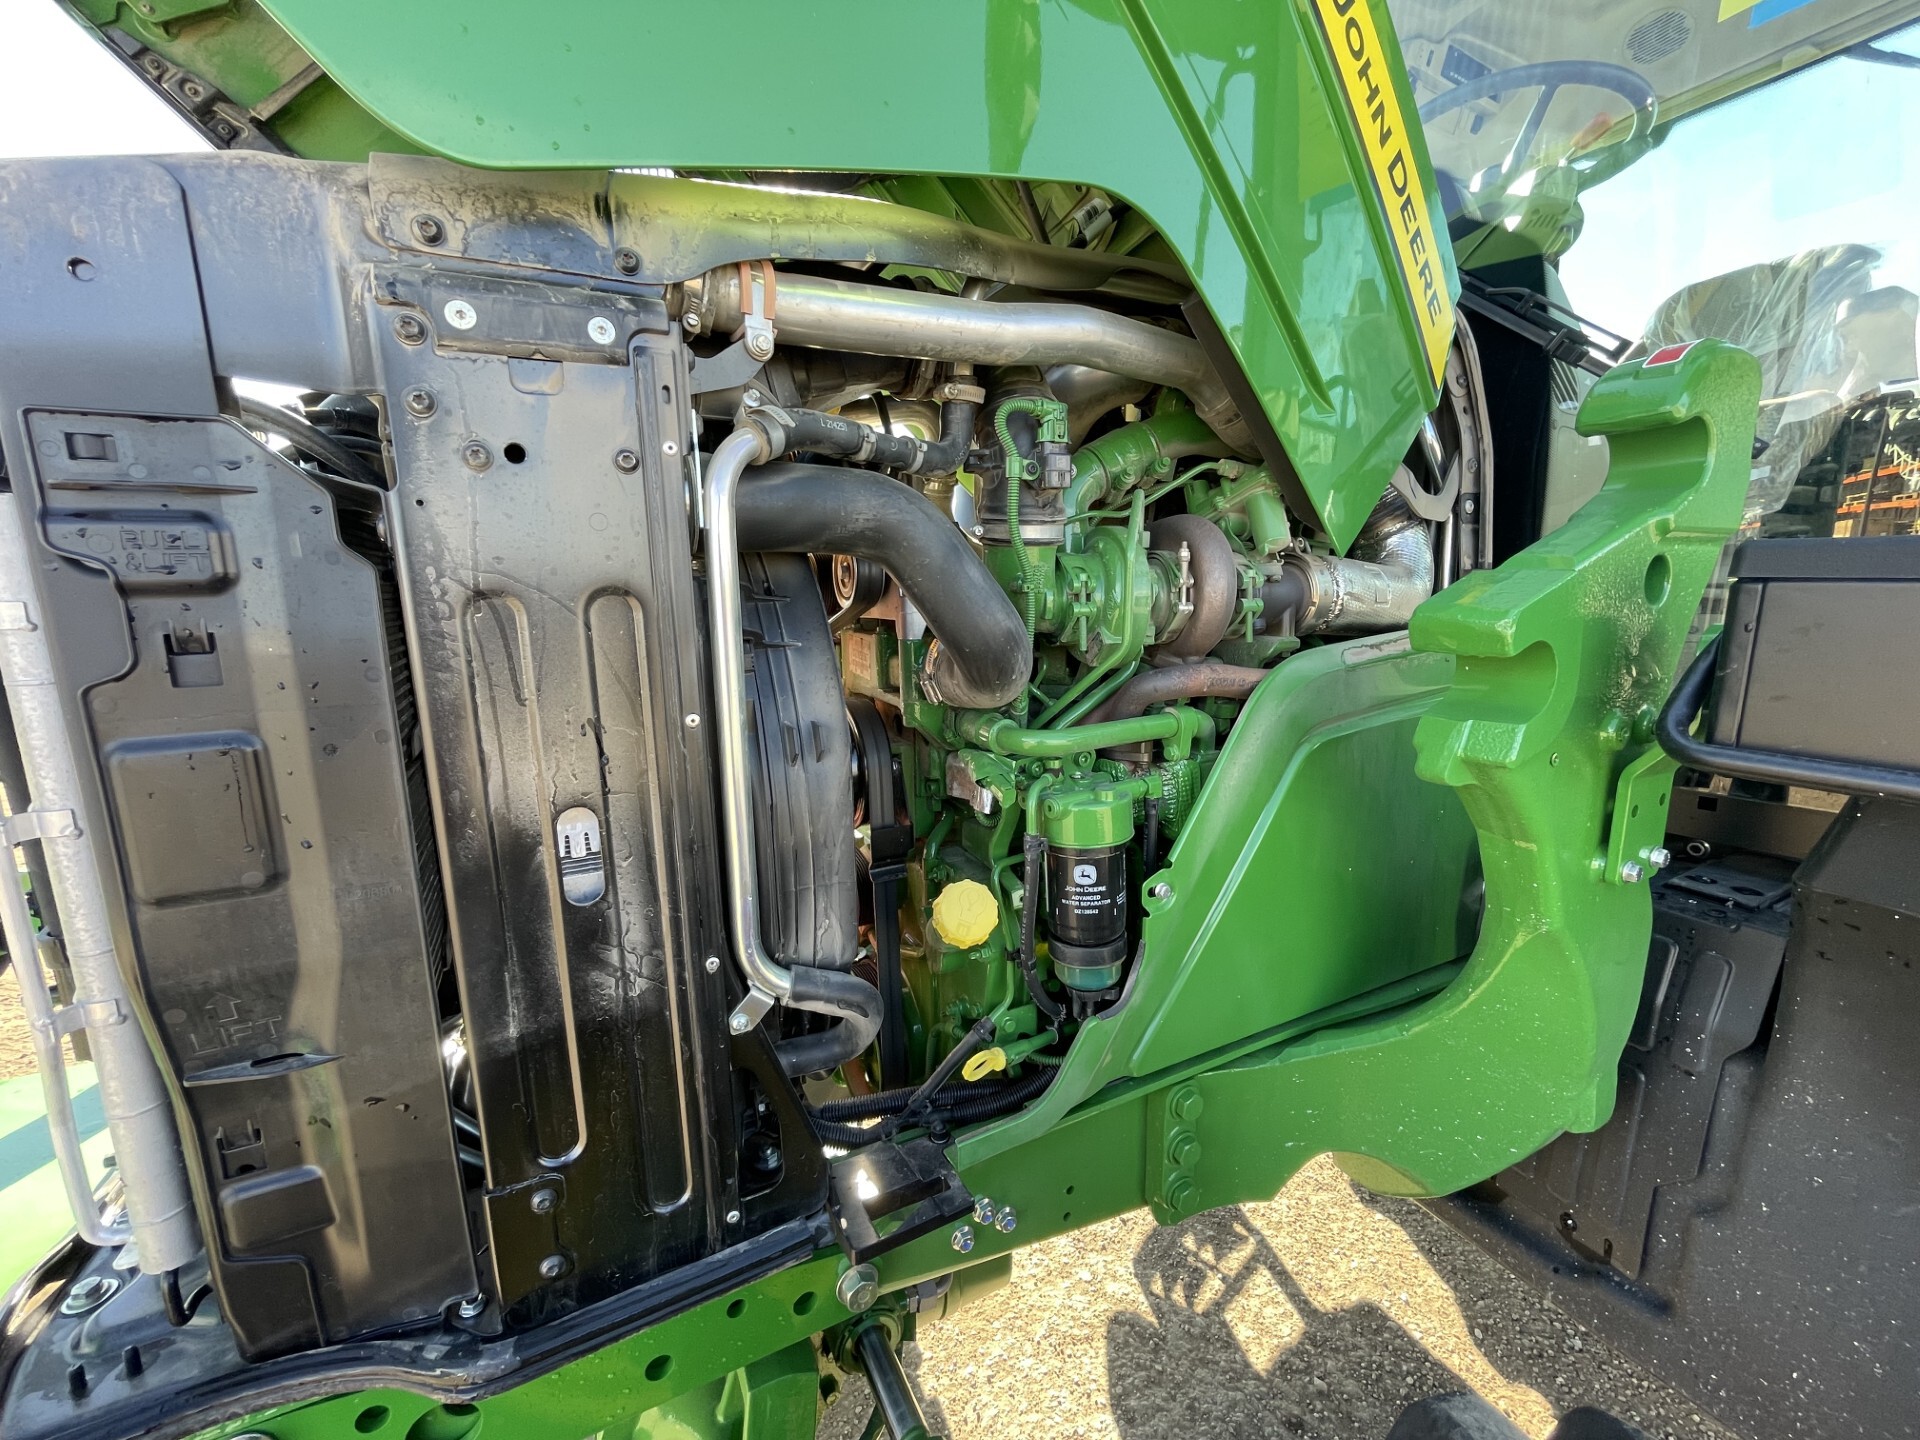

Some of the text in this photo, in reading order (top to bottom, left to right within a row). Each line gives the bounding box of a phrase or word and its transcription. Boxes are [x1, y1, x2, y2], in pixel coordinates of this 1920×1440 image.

[1333, 0, 1443, 327] JOHN DEERE
[120, 529, 201, 551] PULL
[126, 552, 210, 573] & LIFT
[190, 1015, 281, 1055] LIFT
